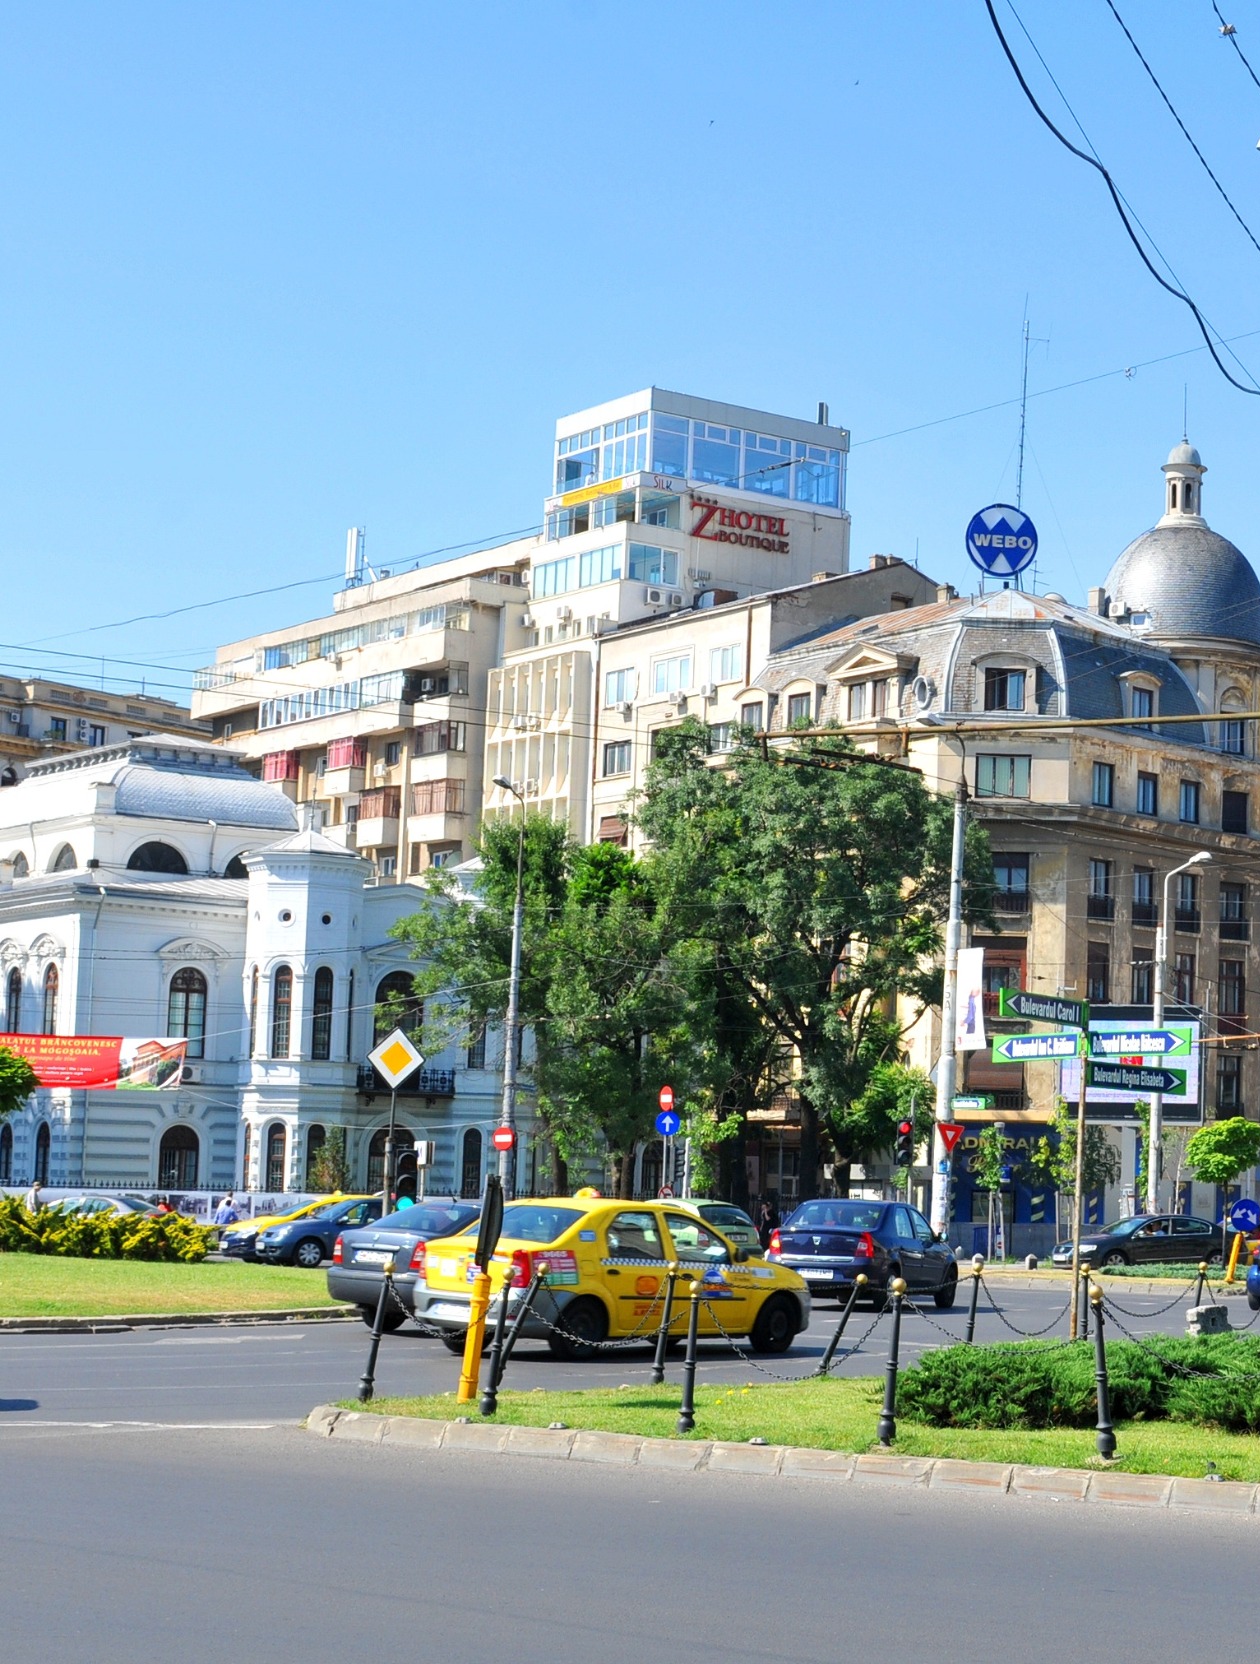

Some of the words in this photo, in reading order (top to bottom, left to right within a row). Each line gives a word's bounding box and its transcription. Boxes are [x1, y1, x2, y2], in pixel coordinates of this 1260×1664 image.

[653, 475, 673, 491] SILK
[718, 507, 790, 537] HOTEL
[718, 530, 790, 554] BOUTIQUE
[973, 533, 1032, 549] WEBO
[1020, 995, 1056, 1018] Bulevardul
[1057, 1002, 1075, 1020] Carol
[0, 1037, 37, 1046] ALATUL
[40, 1036, 117, 1048] BRÂNCOVENESC
[1093, 1066, 1121, 1083] Bulevardul
[1122, 1069, 1140, 1088] Regina
[1140, 1070, 1164, 1087] Elisabeta
